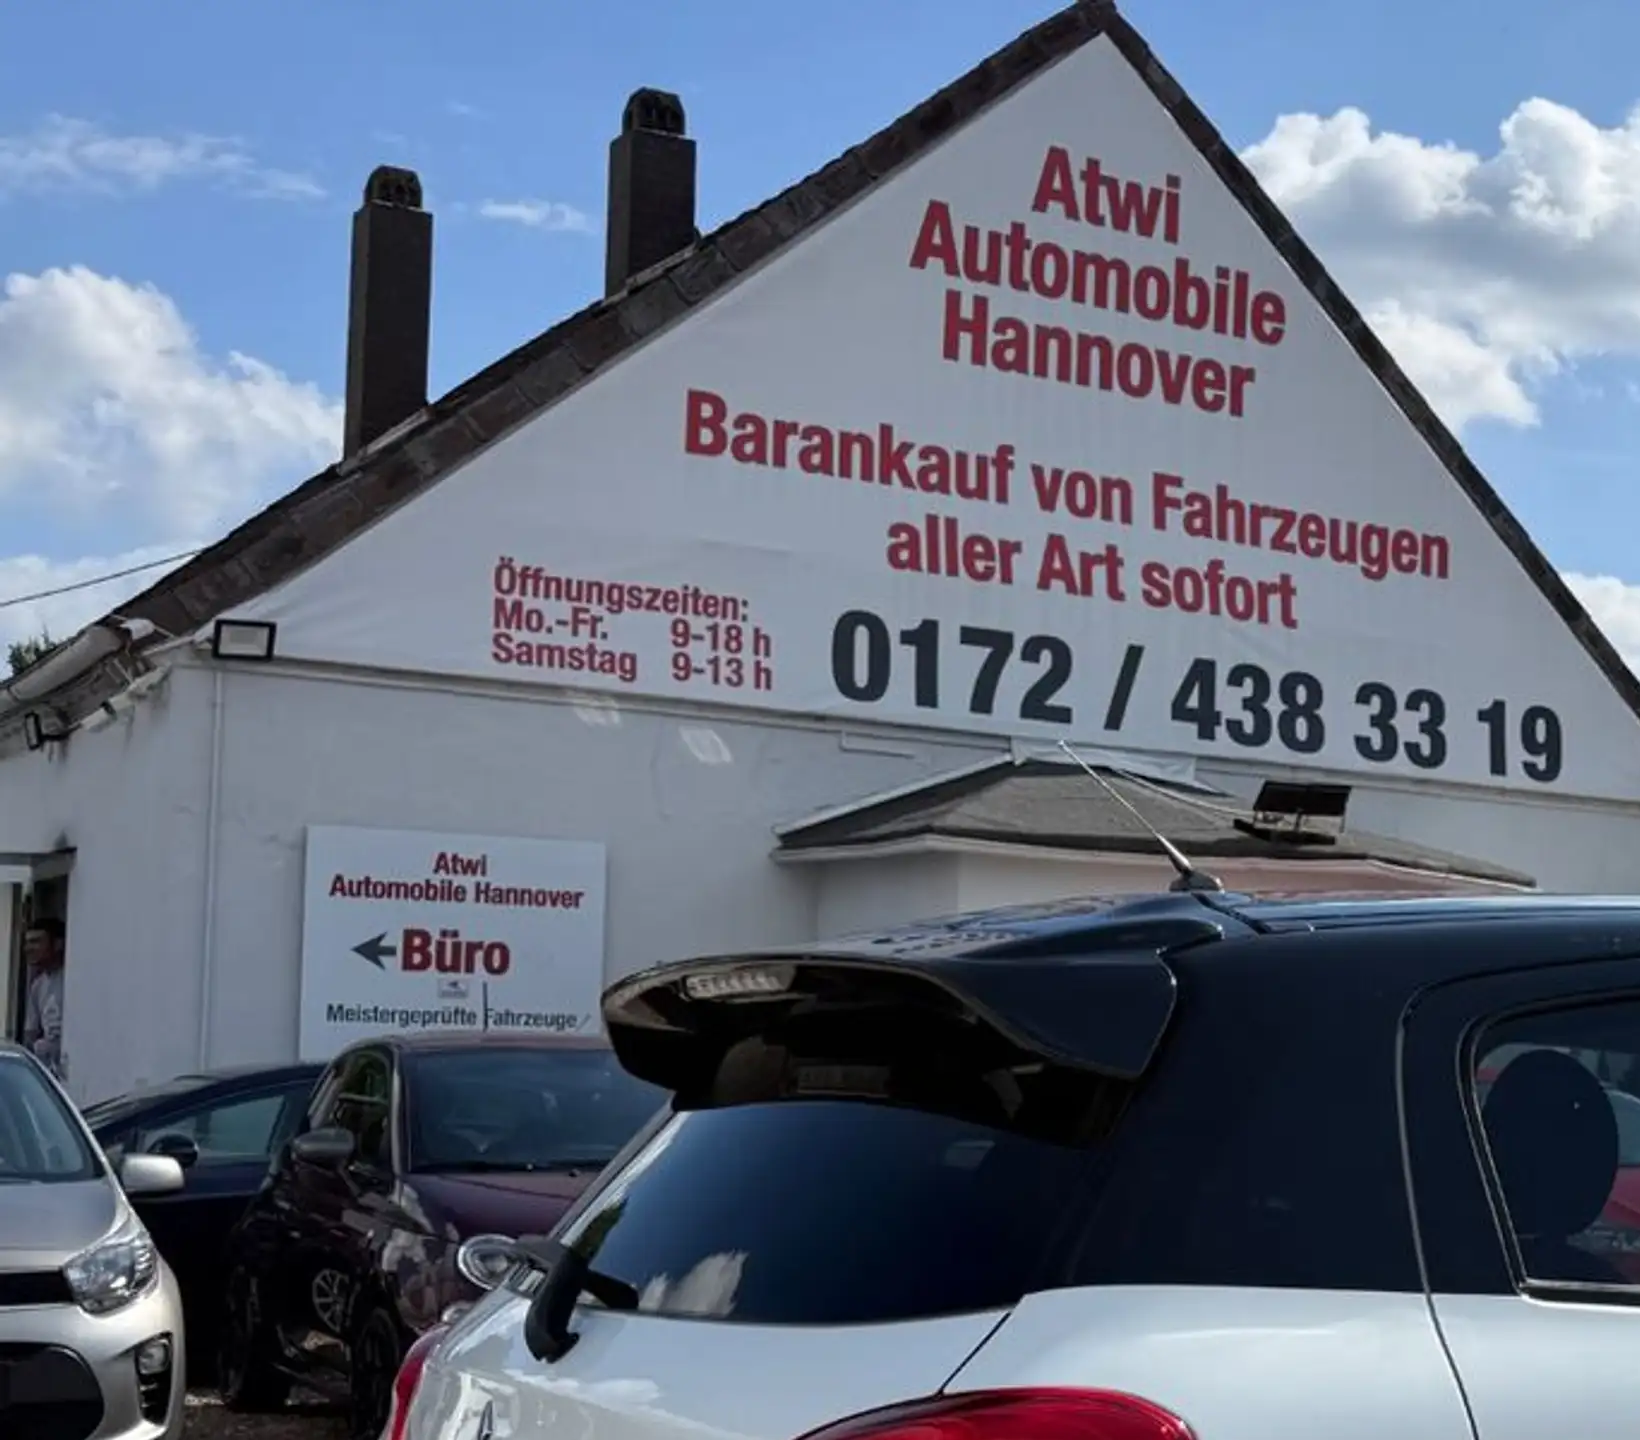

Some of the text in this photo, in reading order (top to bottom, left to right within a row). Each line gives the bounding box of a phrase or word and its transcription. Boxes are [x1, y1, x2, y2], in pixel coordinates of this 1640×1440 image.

[1032, 146, 1181, 244] Atwi
[910, 199, 1287, 346] Automobile
[943, 288, 1256, 417] Hannover
[684, 388, 1450, 581] Barankauf von Fahrzeugen
[494, 556, 749, 622] Öffnungszeiten:
[887, 513, 1298, 629] aller Art sofort
[493, 597, 772, 658] Mo.-Fr. 9-18 h
[492, 632, 773, 691] Samstag 9-13 h
[831, 609, 1562, 783] 0172 / 438 33 19
[329, 874, 584, 909] Automobile Hannover
[432, 851, 488, 877] Atwi
[401, 928, 511, 976] Büro
[326, 1003, 477, 1029] Meistergeprüfte
